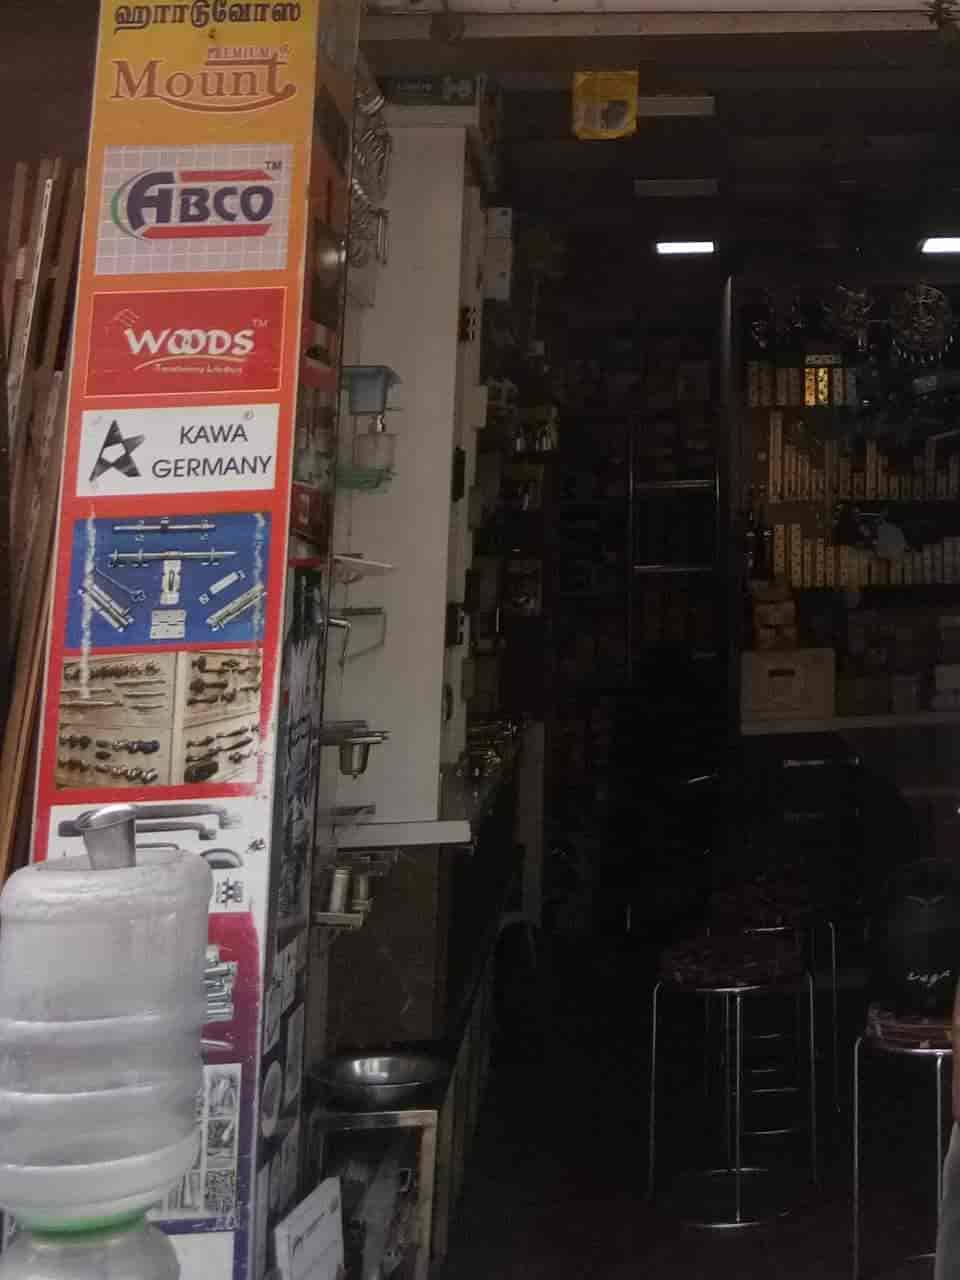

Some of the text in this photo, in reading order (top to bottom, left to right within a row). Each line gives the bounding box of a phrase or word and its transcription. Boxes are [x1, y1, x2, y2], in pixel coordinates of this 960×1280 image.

[111, 56, 297, 112] Mount
[127, 172, 274, 231] ABCO
[124, 328, 255, 355] WOODS
[179, 424, 248, 444] KAWA
[152, 456, 272, 478] GERMANY
